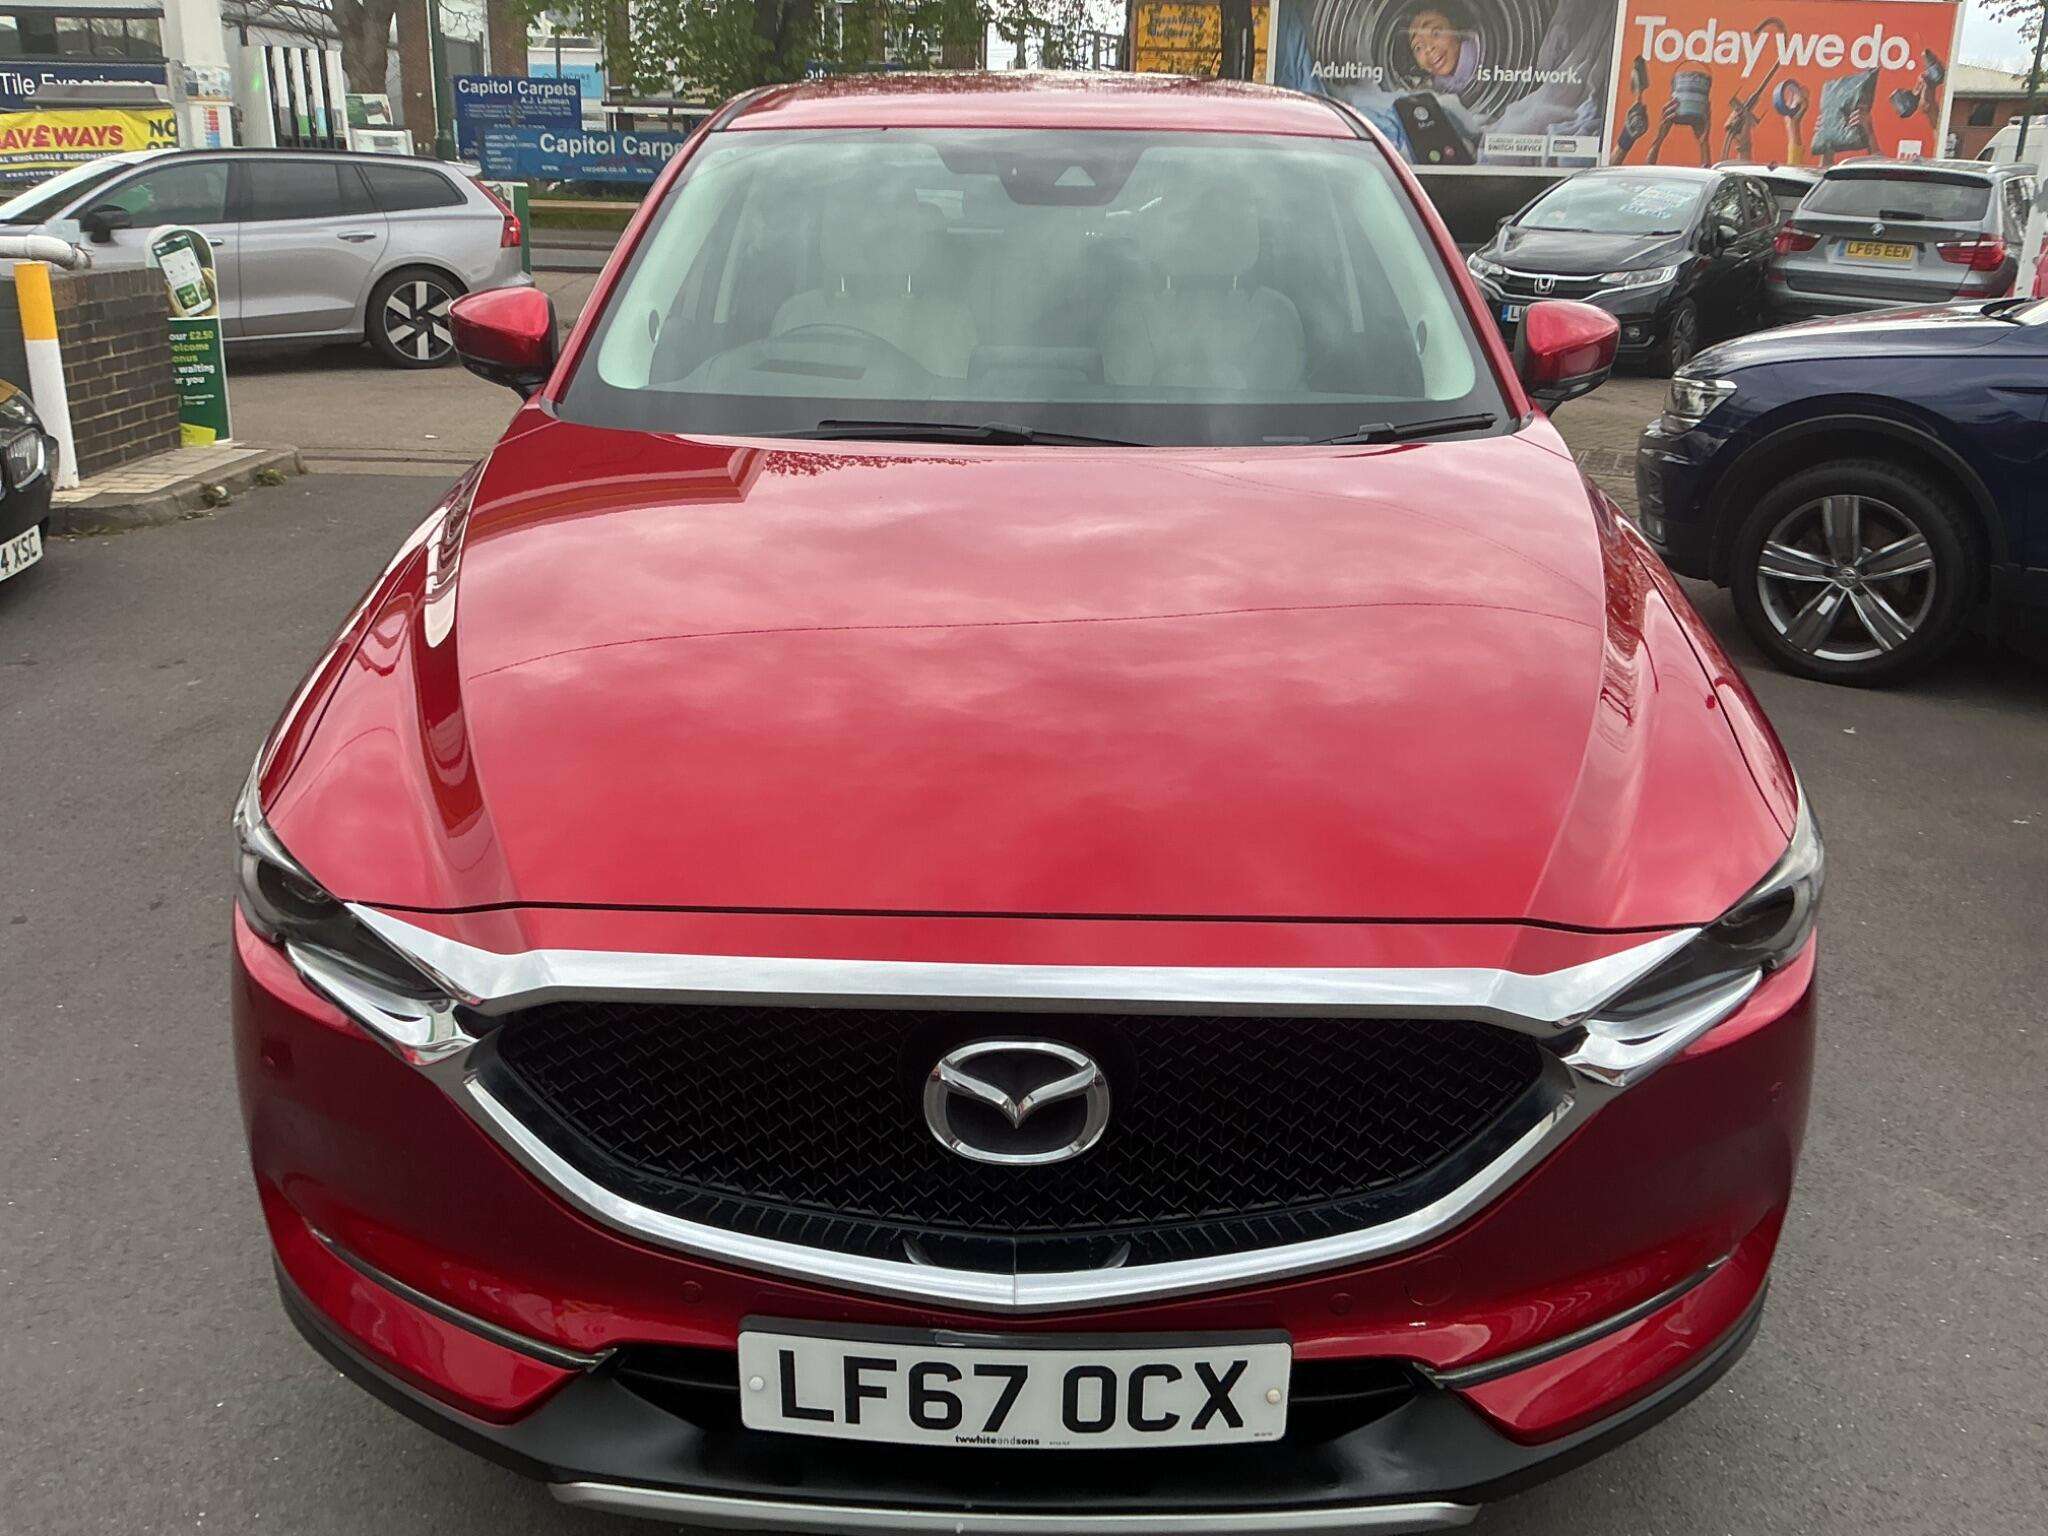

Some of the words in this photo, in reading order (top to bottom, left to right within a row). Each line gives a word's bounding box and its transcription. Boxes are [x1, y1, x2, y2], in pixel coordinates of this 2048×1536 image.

[1635, 16, 1768, 78] Today
[1775, 32, 1844, 67] we
[1851, 24, 1916, 71] do.
[1311, 61, 1383, 83] Adulting
[1477, 65, 1490, 81] is
[1495, 66, 1531, 82] hard
[1533, 69, 1582, 84] work.
[0, 73, 35, 95] Tile
[458, 79, 512, 97] Capitol
[517, 81, 577, 98] Carpets
[0, 125, 124, 150] AV£WAYS
[540, 133, 615, 158] Capitol
[622, 135, 684, 161] Carpe
[1516, 144, 1542, 152] SERVICE
[1848, 242, 1881, 256] LF65
[1884, 245, 1912, 258] EEN
[190, 331, 214, 340] £2.50
[172, 343, 209, 352] elcome
[178, 363, 215, 374] waiting
[186, 377, 206, 386] you
[778, 1349, 1028, 1433] LF67
[1062, 1359, 1249, 1433] OCX
